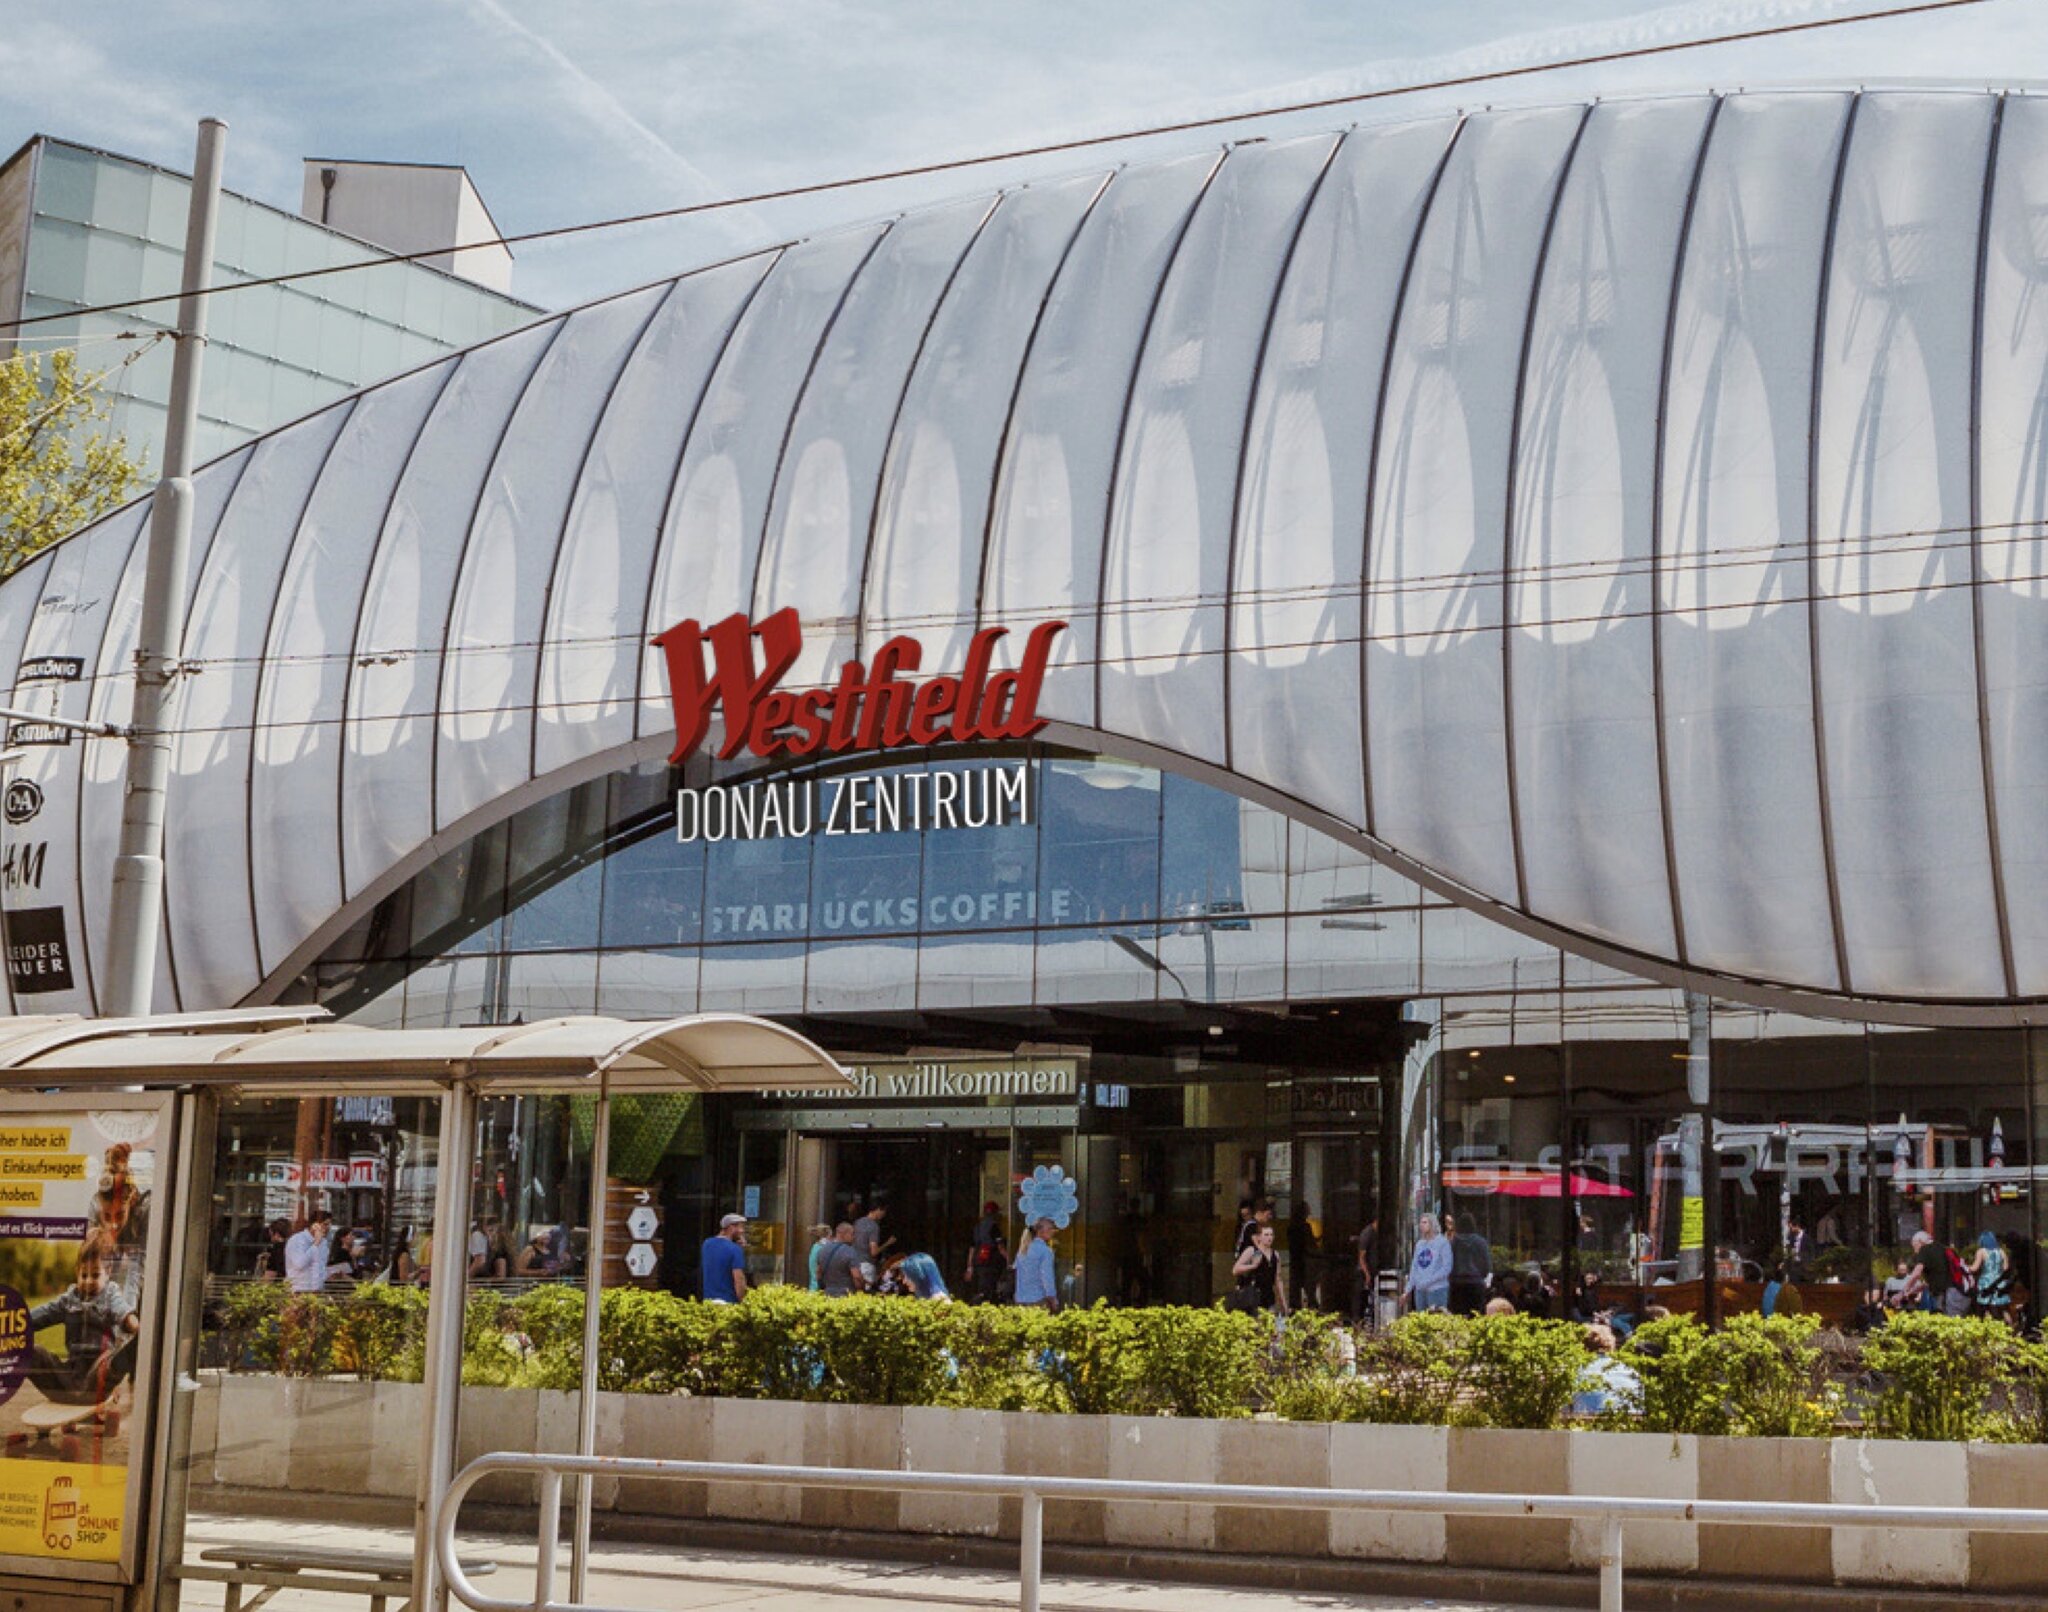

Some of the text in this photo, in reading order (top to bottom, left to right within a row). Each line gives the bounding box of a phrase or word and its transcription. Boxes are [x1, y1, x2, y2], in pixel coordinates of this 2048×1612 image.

[649, 606, 1069, 764] Westfield
[677, 766, 1027, 843] DONAU ZENTRUM
[888, 1065, 1069, 1097] willkommen
[21, 1132, 48, 1148] habe
[50, 1133, 66, 1148] ich
[78, 1516, 119, 1531] ONLINE
[77, 1531, 107, 1543] SHOP
